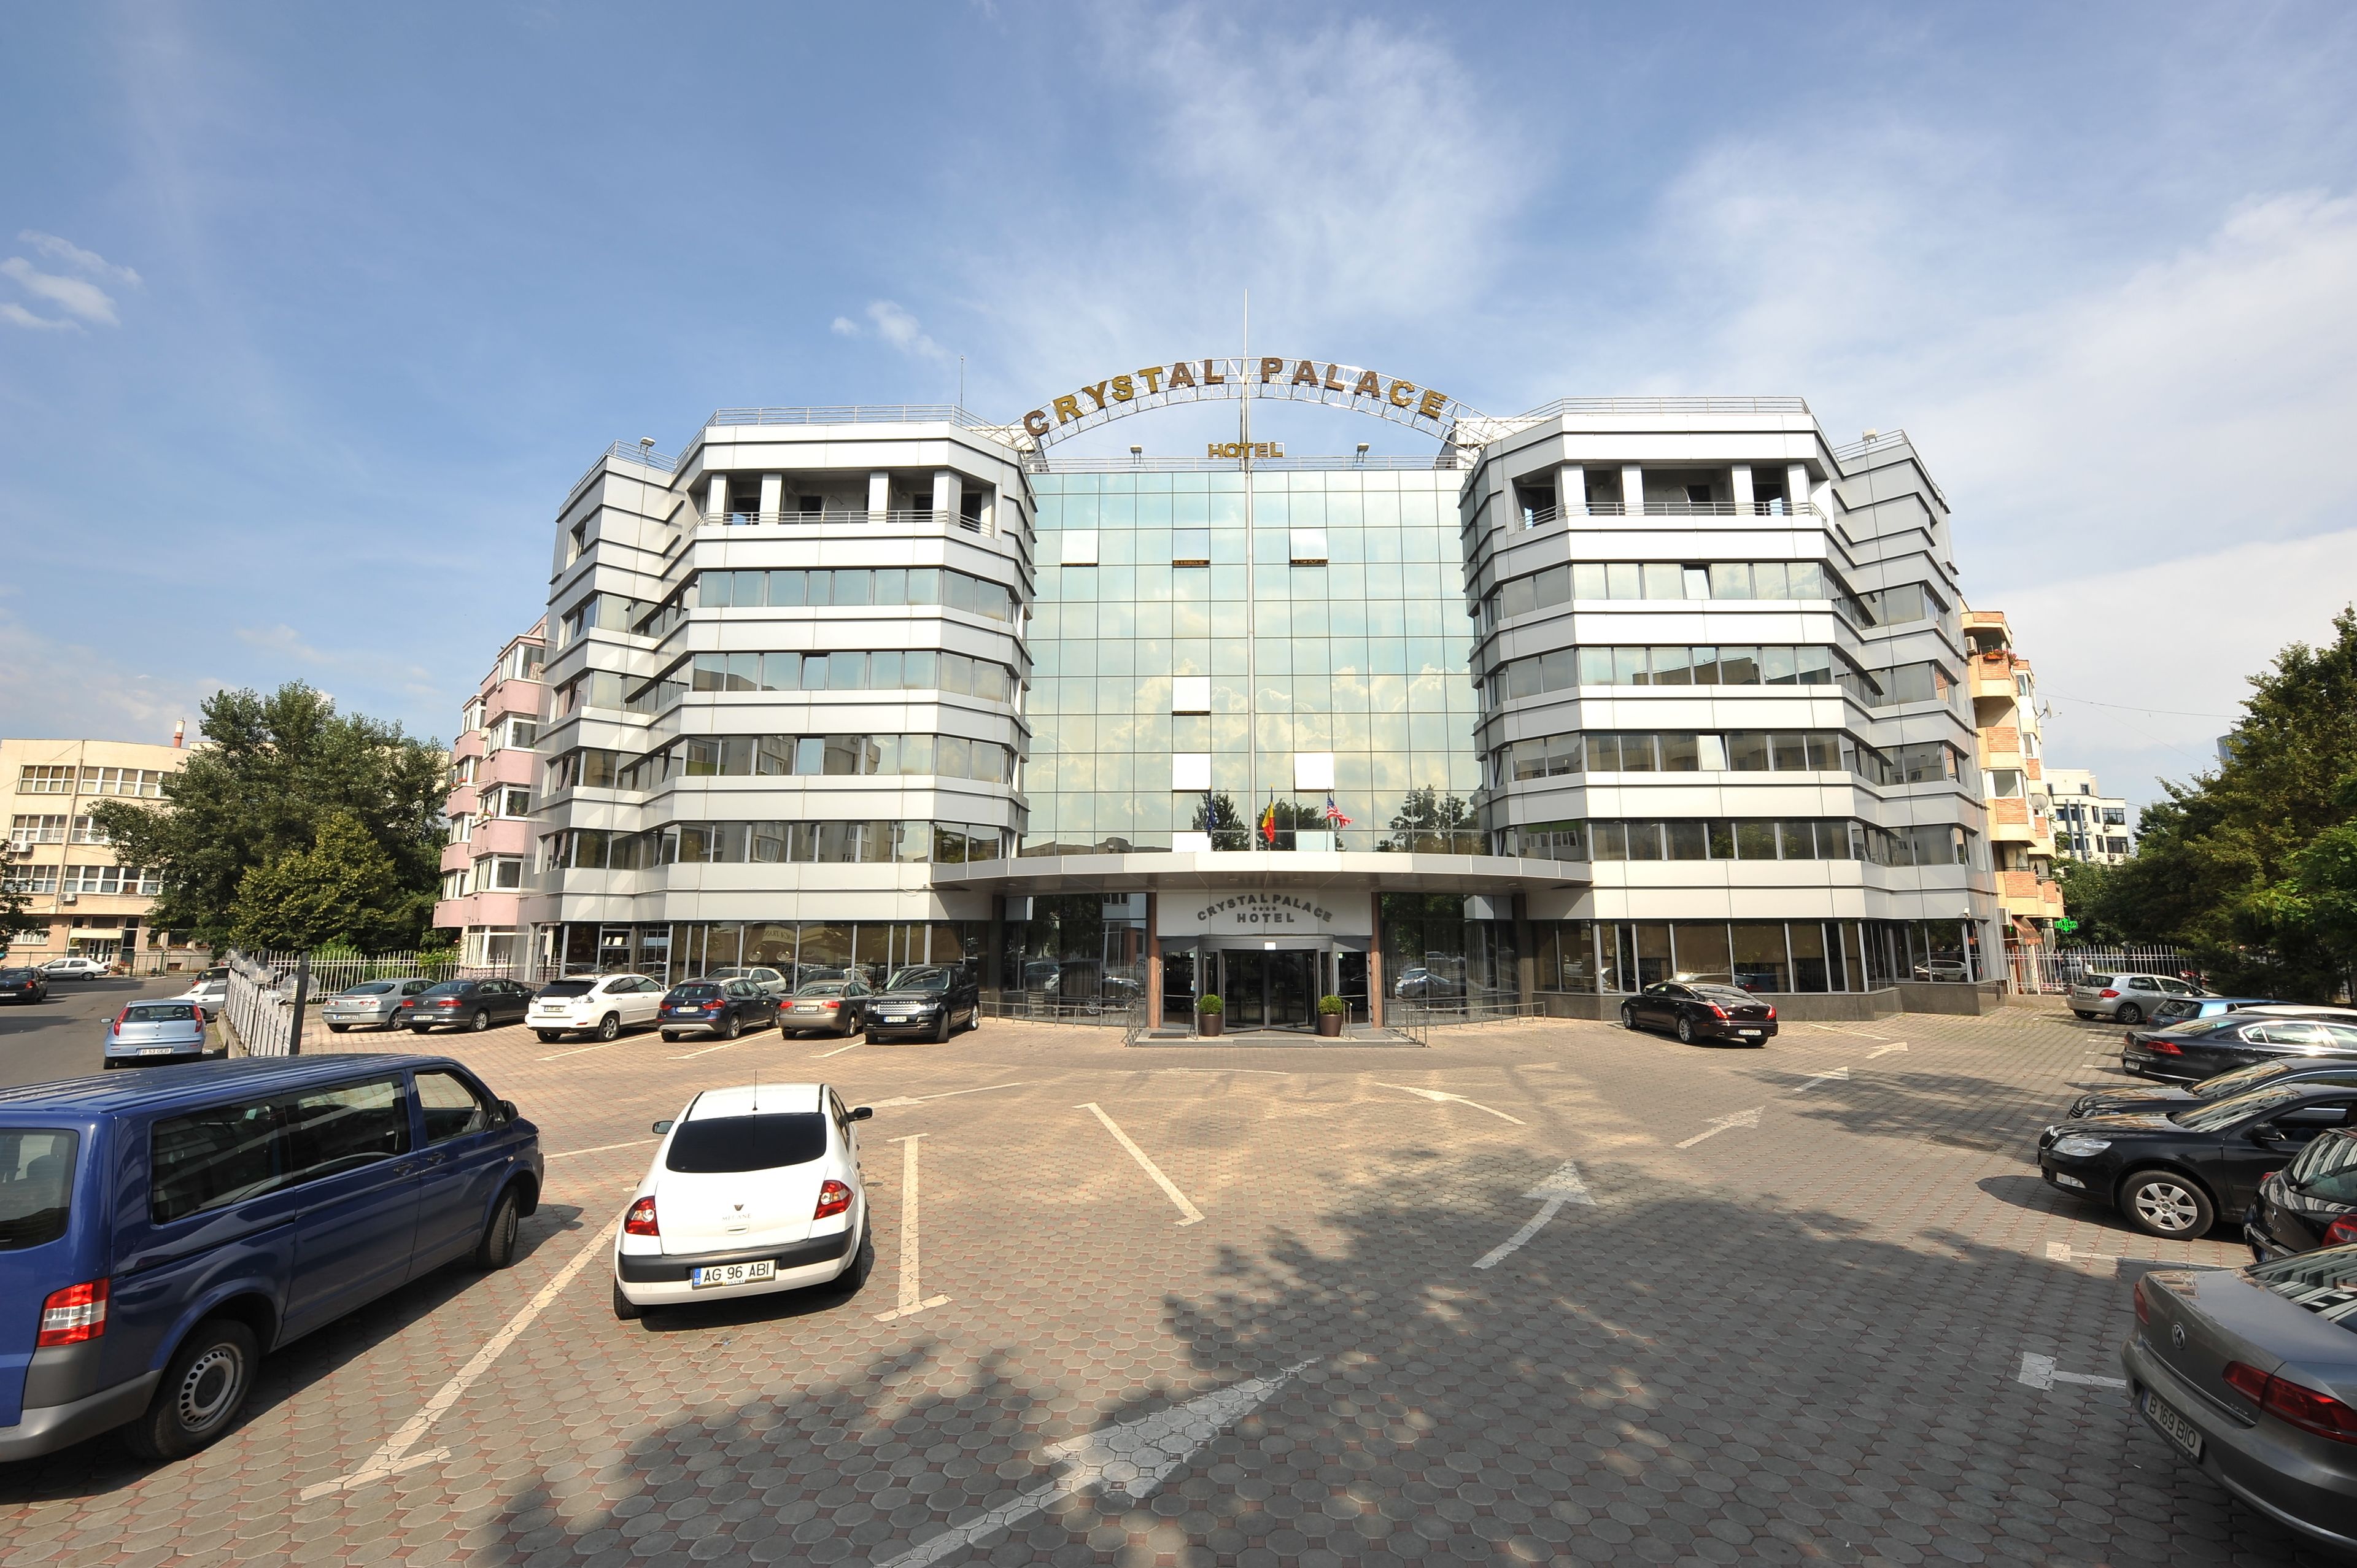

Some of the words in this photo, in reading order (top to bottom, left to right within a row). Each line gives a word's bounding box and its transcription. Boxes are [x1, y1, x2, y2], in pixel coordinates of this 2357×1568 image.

[1023, 359, 1225, 436] CRYSTAL
[1261, 357, 1448, 420] PALACE
[1208, 442, 1283, 458] HOTEL
[1197, 894, 1268, 921] CRYSTAL
[1272, 894, 1333, 922] PALACE
[1237, 913, 1295, 923] HOTEL
[703, 1268, 722, 1283] AG
[727, 1266, 743, 1280] 96
[749, 1262, 769, 1277] ABI
[2149, 1396, 2157, 1415] B
[2159, 1405, 2175, 1431] 169
[2176, 1419, 2196, 1448] BIO
